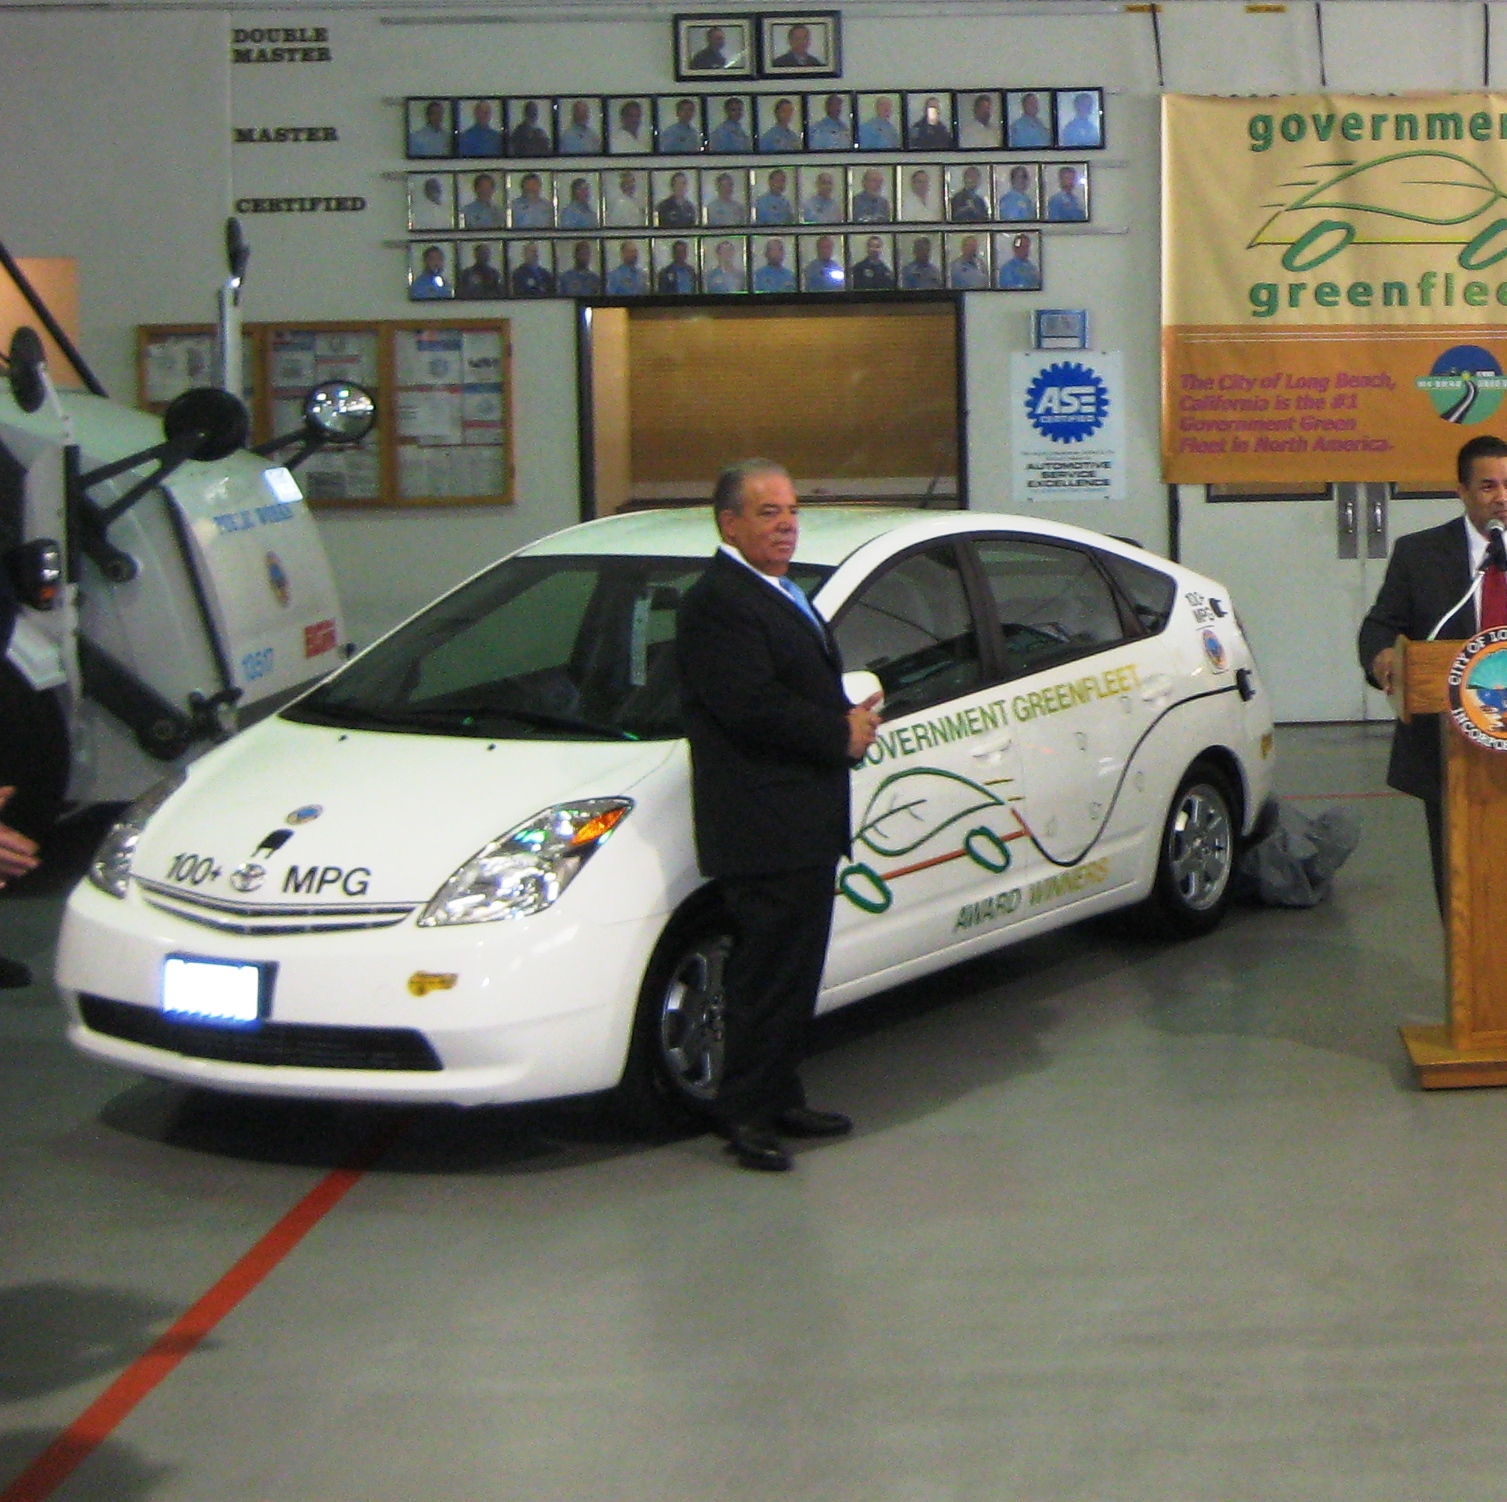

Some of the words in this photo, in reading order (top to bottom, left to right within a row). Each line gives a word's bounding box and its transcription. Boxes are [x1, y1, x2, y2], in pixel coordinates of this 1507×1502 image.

[232, 28, 328, 43] DOUBLE
[231, 48, 332, 63] MASTER
[232, 127, 339, 142] MASTER
[235, 197, 366, 213] CERTIFIED
[1180, 373, 1215, 391] The
[1218, 374, 1256, 391] City
[1260, 373, 1283, 389] of
[1285, 374, 1330, 393] Long
[1335, 372, 1395, 390] Beach,
[1035, 386, 1096, 414] ASE
[1179, 395, 1269, 411] California
[1274, 395, 1290, 410] is
[1295, 394, 1326, 410] the
[1331, 394, 1357, 410] #1
[1179, 416, 1296, 431] Government
[1300, 415, 1357, 431] Green
[1180, 437, 1226, 453] Fleet
[1231, 436, 1249, 452] in
[1255, 436, 1308, 452] North
[1026, 461, 1111, 470] AUTOMOTIVE
[1042, 470, 1096, 479] SERVICE
[1027, 479, 1110, 488] EXCELLENCE
[1448, 653, 1469, 685] CITY
[1466, 636, 1486, 653] OF
[1011, 664, 1140, 722] GREENFLEET
[166, 852, 222, 886] 100+
[282, 865, 371, 896] MPG
[953, 887, 1022, 932] AWARD
[1029, 857, 1109, 905] WINNERS
